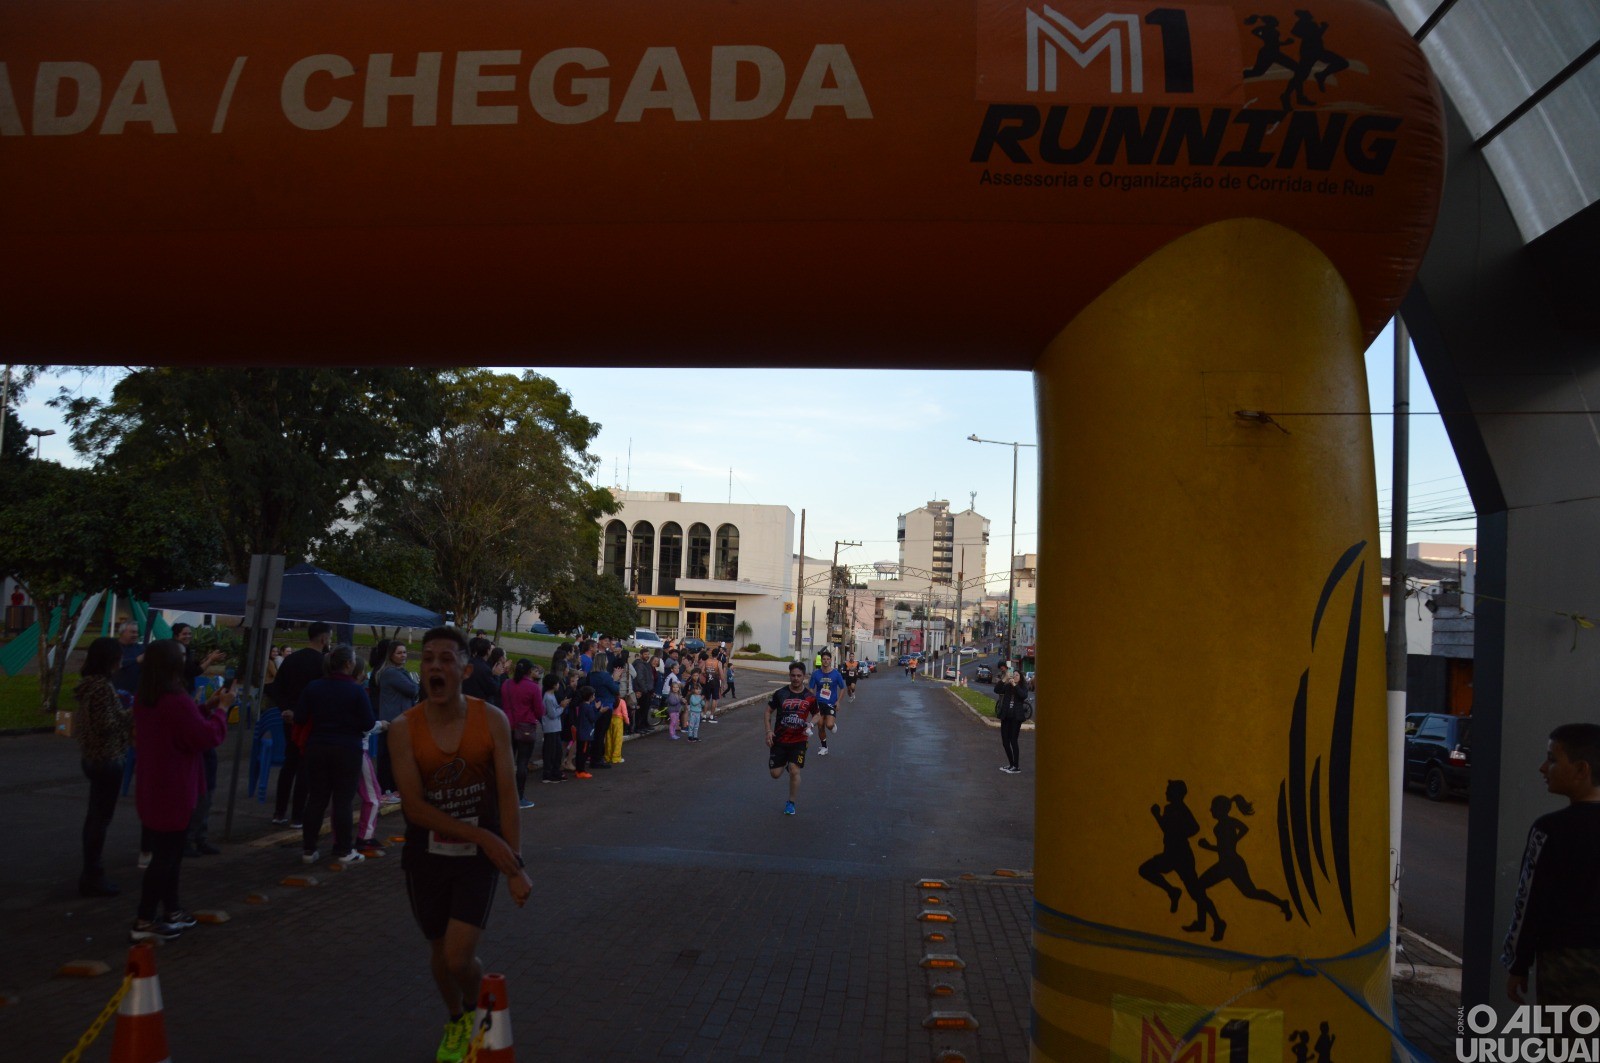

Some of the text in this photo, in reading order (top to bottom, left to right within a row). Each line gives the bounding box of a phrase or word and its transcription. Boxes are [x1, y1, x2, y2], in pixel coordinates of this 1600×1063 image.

[279, 43, 874, 132] CHEGADA
[1024, 4, 1194, 94] M1
[969, 103, 1404, 176] RUNNING
[979, 169, 1375, 198] Assessoria e Organização de Corrida de Rua
